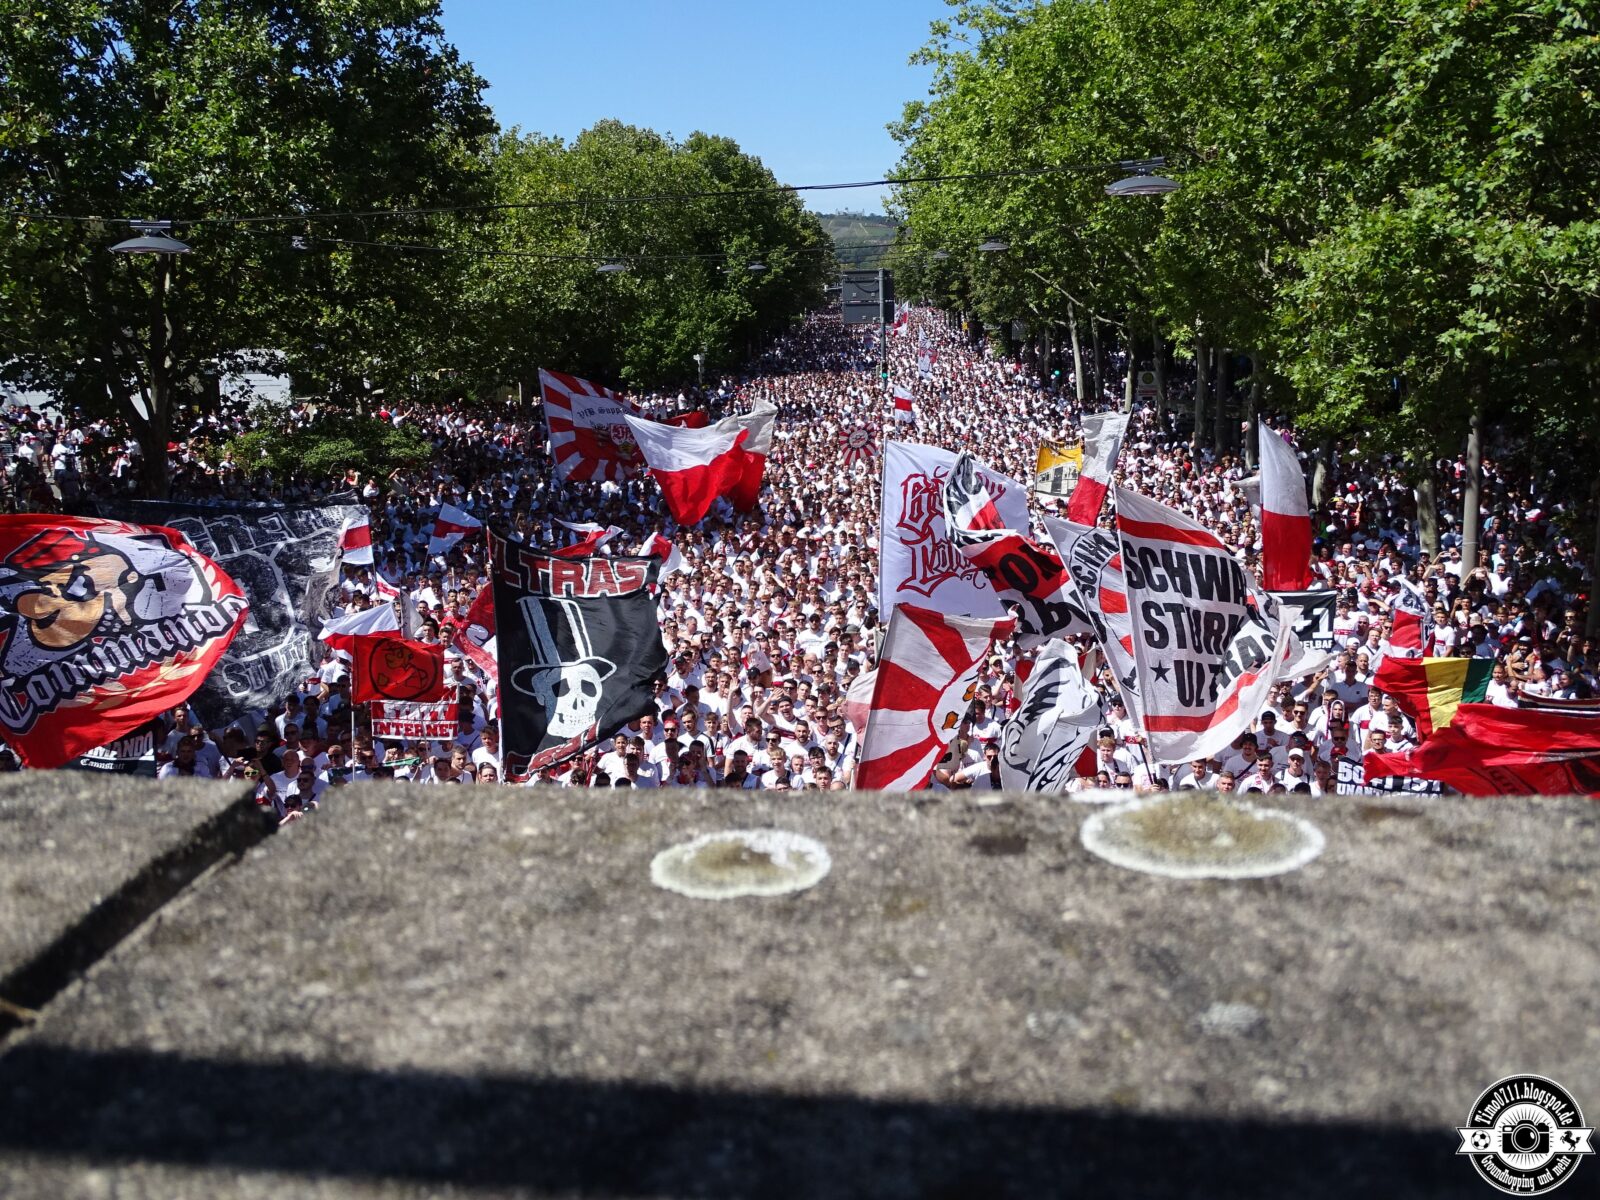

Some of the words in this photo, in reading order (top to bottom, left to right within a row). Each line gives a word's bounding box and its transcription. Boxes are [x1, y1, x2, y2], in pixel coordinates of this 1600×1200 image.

[490, 531, 652, 598] LTRAS
[1122, 539, 1247, 607] SCHWA
[0, 597, 249, 730] Commando
[372, 721, 458, 737] INTERNET
